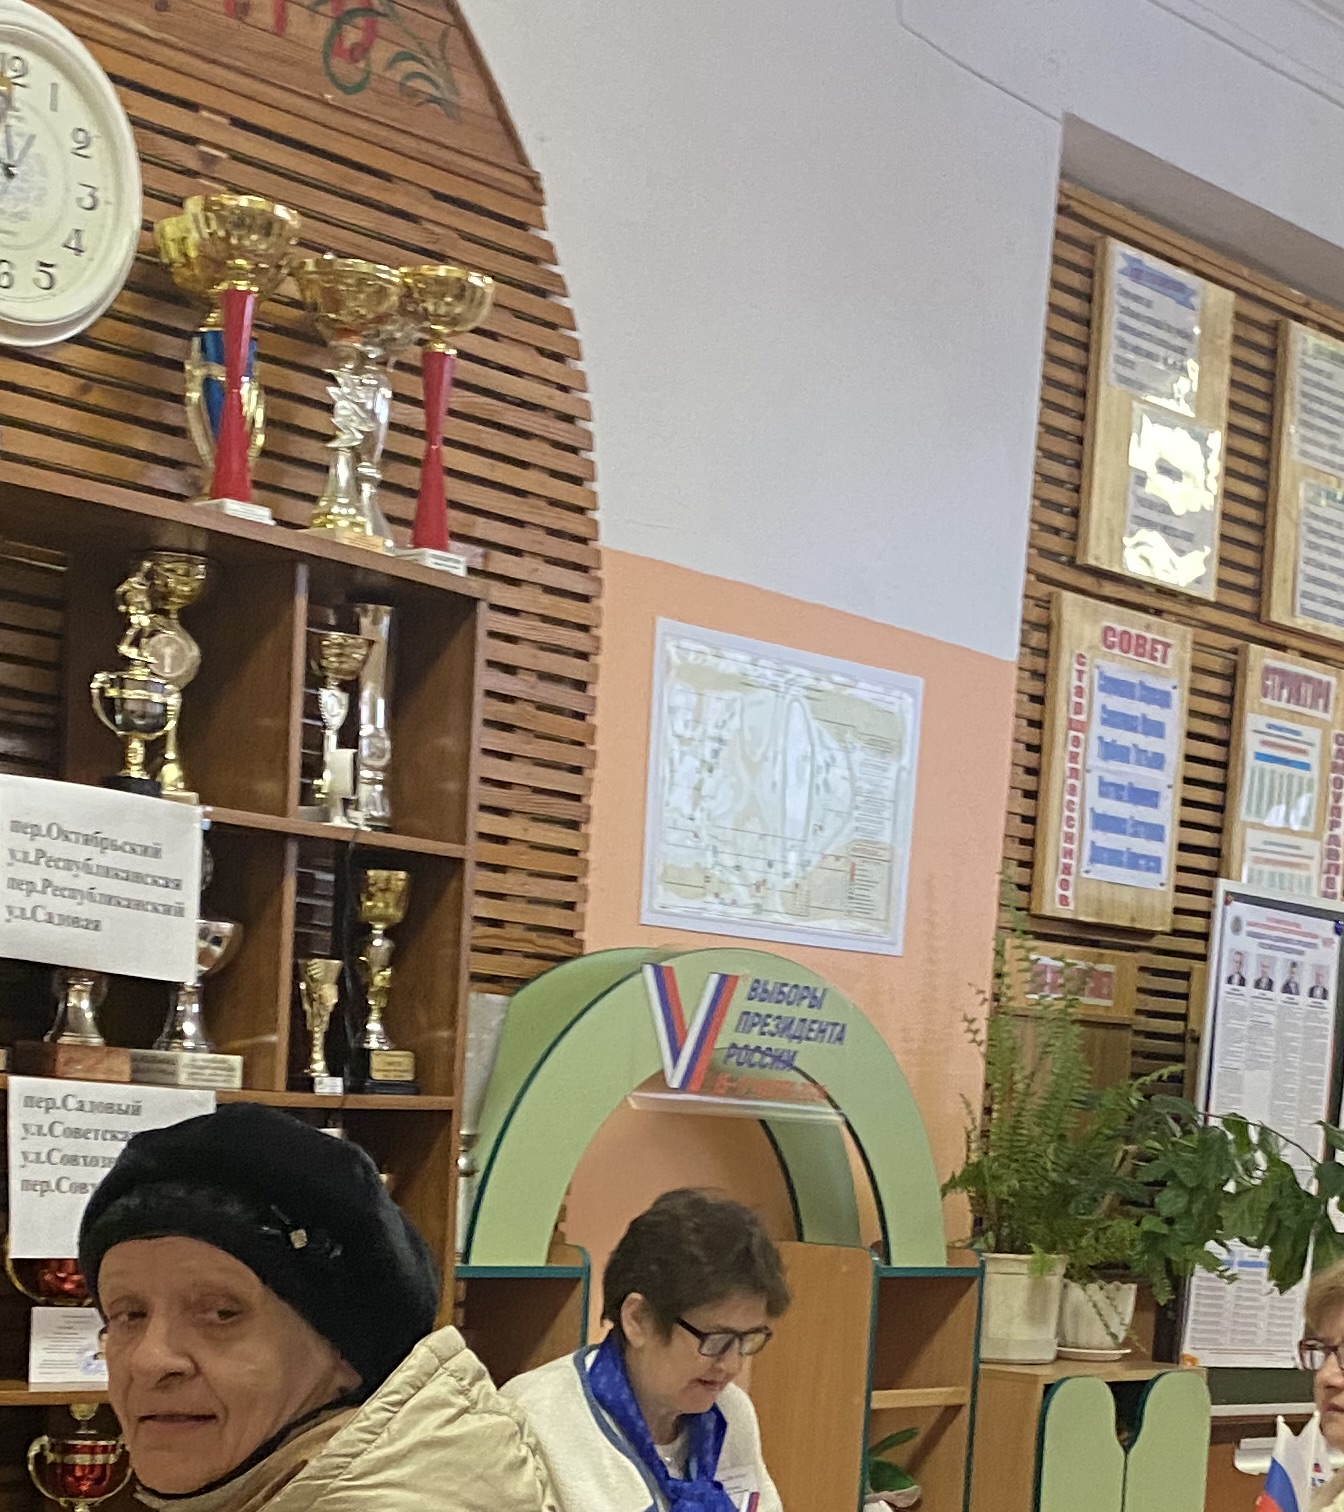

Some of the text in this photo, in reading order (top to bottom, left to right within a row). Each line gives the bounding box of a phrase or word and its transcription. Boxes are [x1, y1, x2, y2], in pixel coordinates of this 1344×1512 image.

[70, 127, 92, 160] 2
[76, 182, 99, 211] 3
[63, 228, 85, 257] 4
[32, 260, 57, 290] 5
[1102, 624, 1172, 665] СОВЕТ
[4, 904, 102, 932] ул.Садовая
[746, 977, 828, 1011] ВЫБОРЫ
[734, 1009, 848, 1046] ПРЕЗИДЕНТА
[722, 1042, 799, 1072] РОССИИ
[22, 1093, 143, 1117] пер.Садовый
